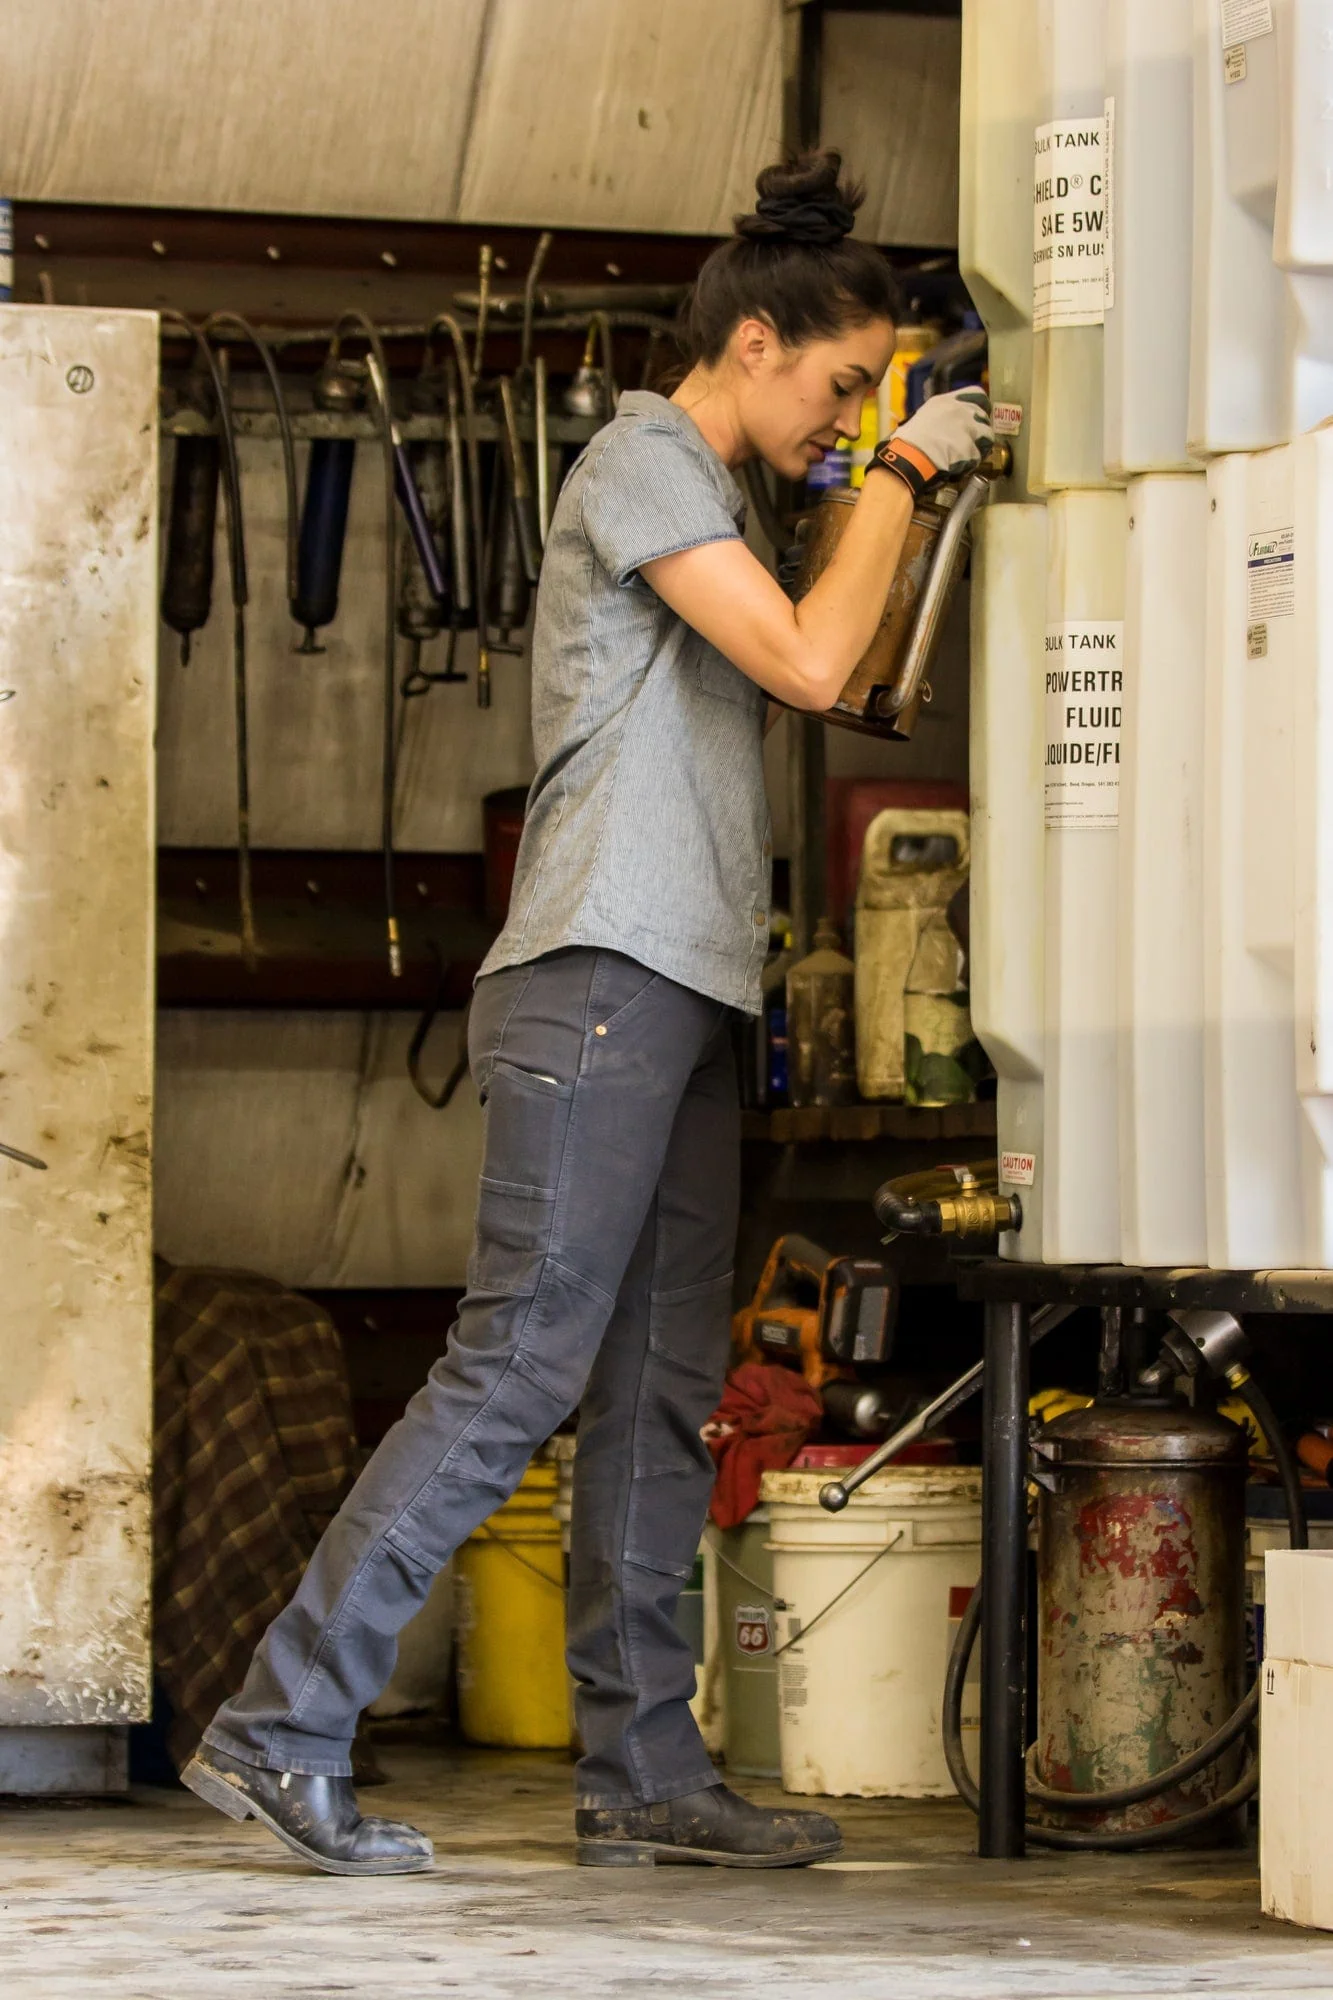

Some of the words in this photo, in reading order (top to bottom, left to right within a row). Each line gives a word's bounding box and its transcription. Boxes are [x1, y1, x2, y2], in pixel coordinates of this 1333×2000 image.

[1054, 131, 1100, 148] TANK
[1034, 174, 1083, 204] HIELD®
[1041, 213, 1065, 238] SAE
[1072, 210, 1104, 232] 5W
[1058, 245, 1073, 257] SN
[994, 407, 1021, 421] CAUTION
[1068, 634, 1116, 649] TANK
[1046, 670, 1123, 694] POWERTR
[1066, 707, 1122, 728] FLUID
[1002, 1156, 1032, 1170] CAUTION
[739, 1625, 764, 1646] 66
